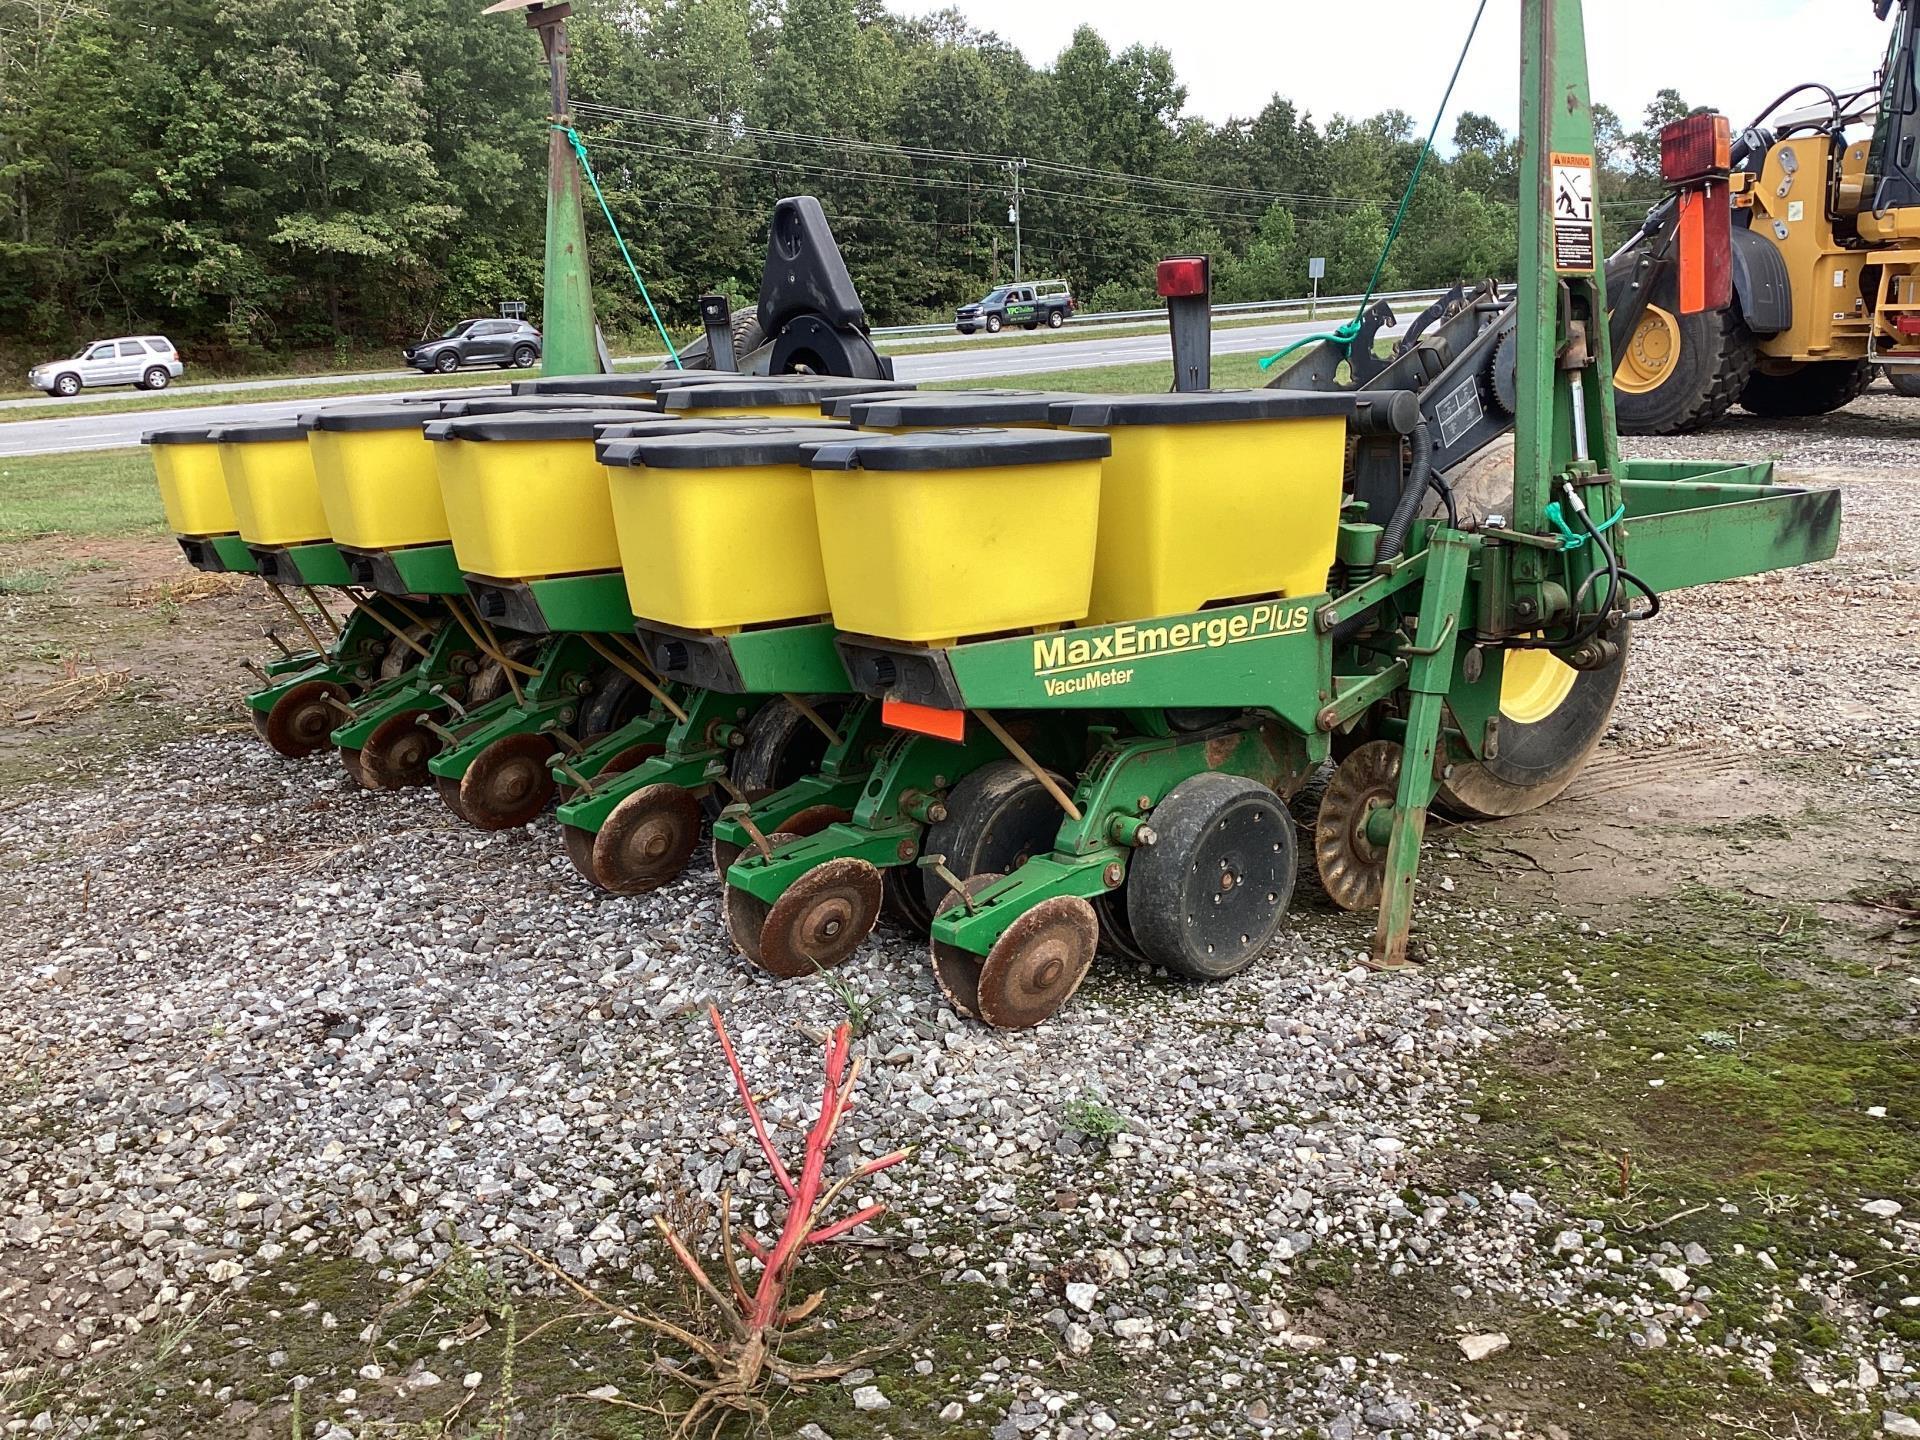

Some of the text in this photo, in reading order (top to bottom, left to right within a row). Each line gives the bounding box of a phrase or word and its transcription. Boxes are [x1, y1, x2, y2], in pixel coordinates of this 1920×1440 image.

[1560, 156, 1589, 166] WARNING
[1033, 604, 1309, 670] MaxEmergePlus
[1044, 669, 1134, 697] VacuMeter
